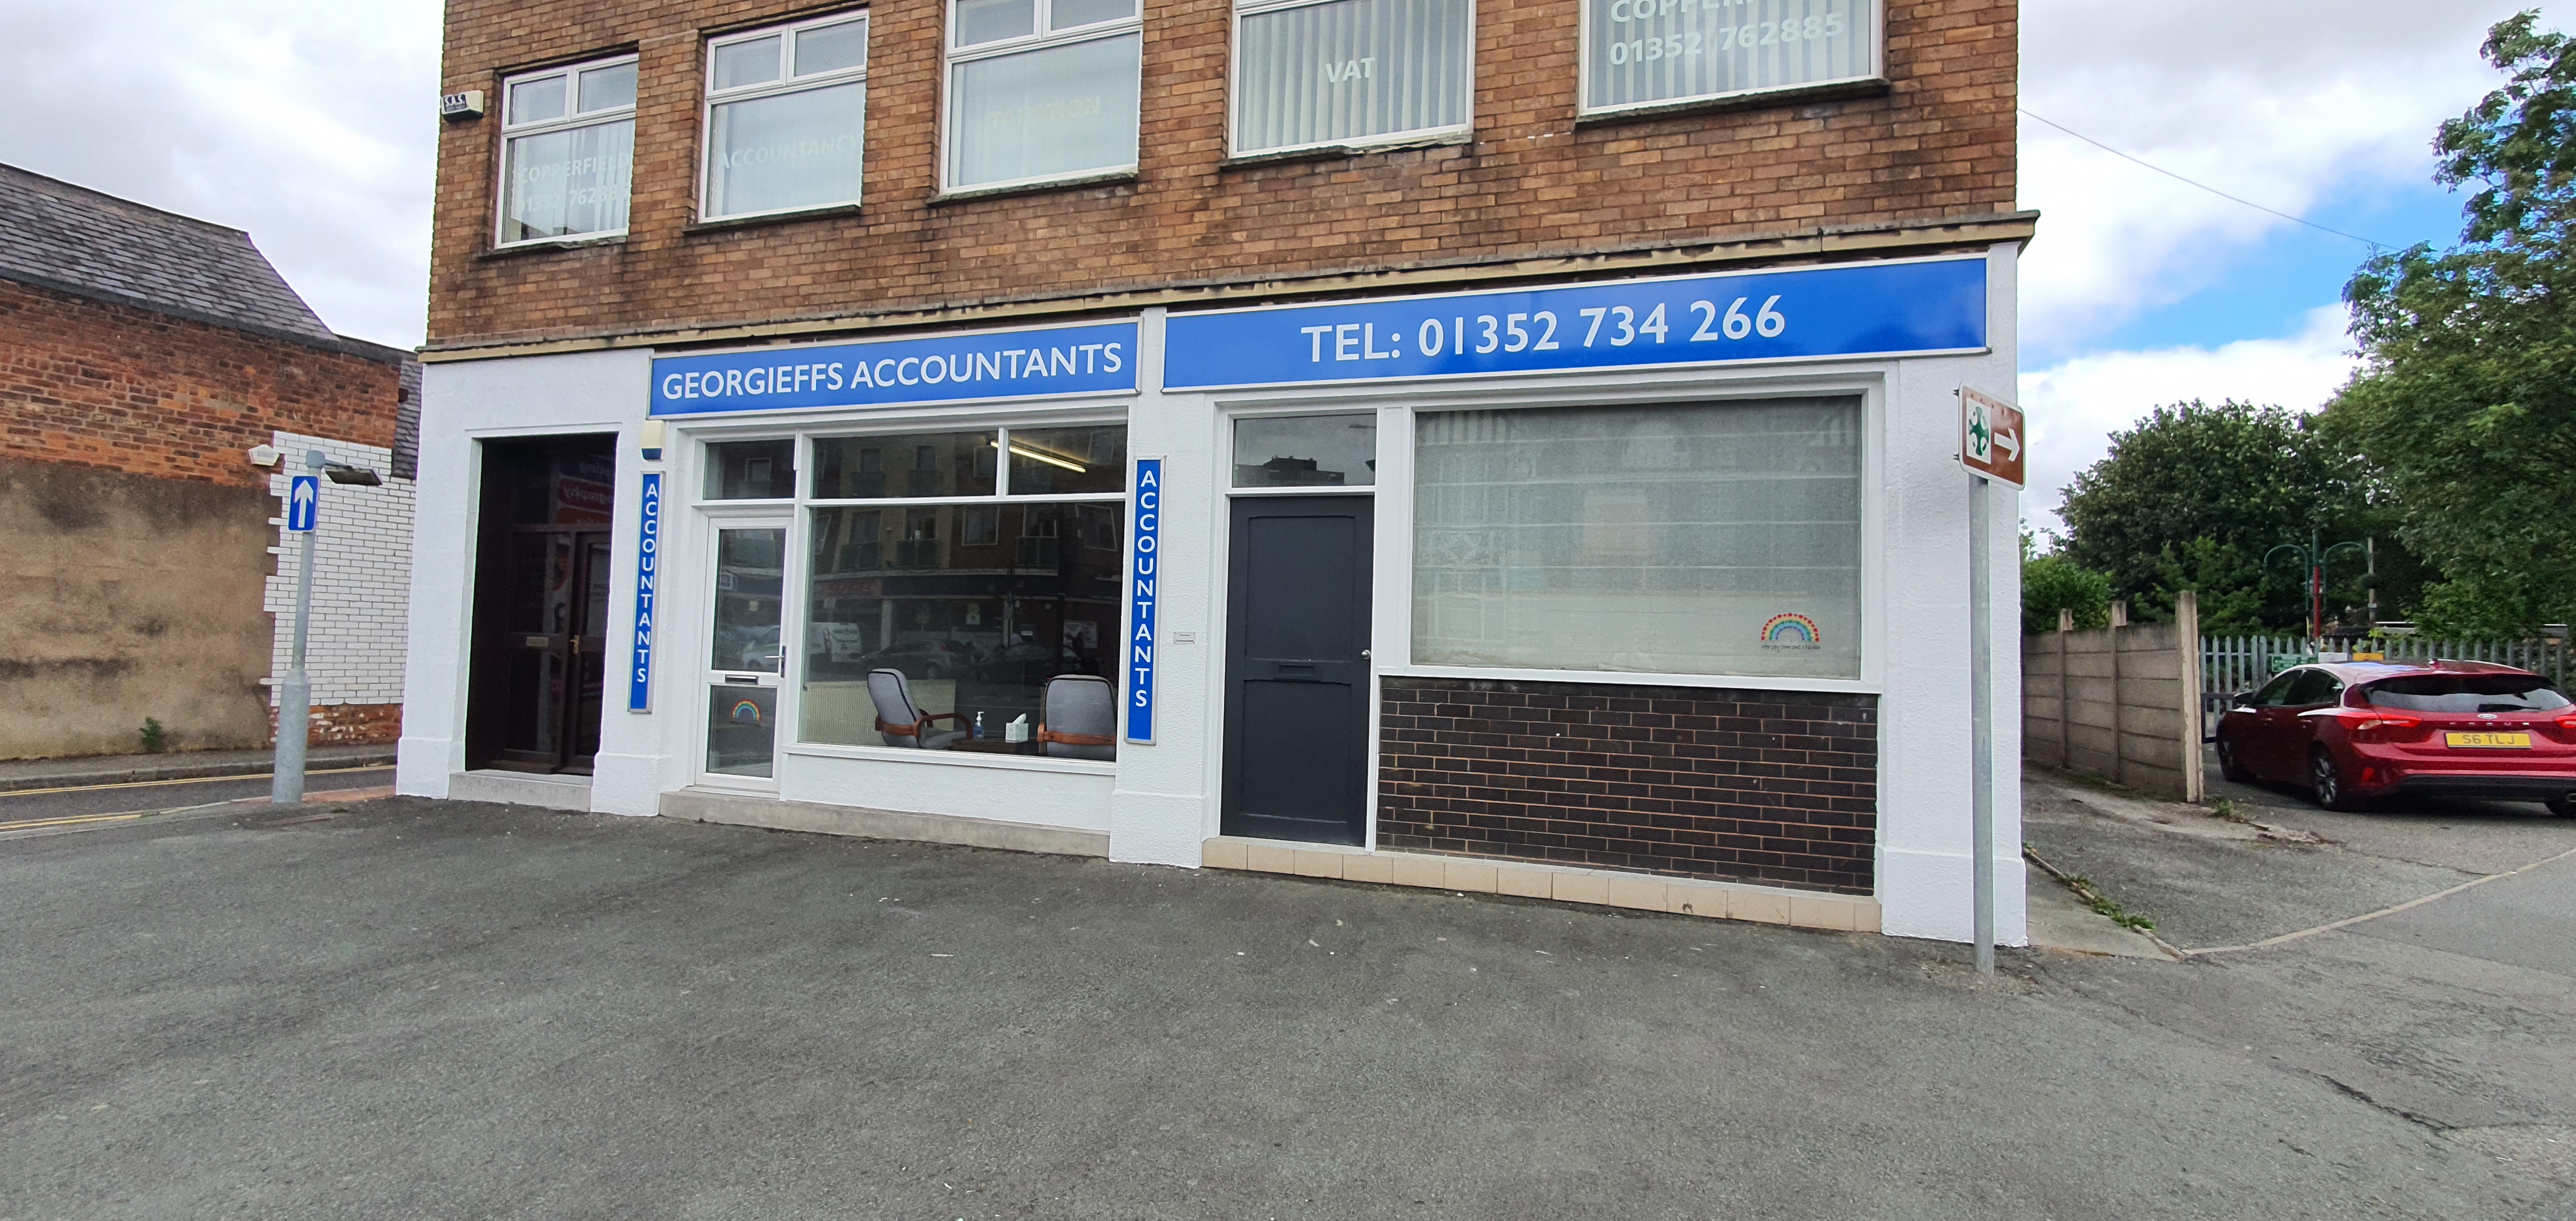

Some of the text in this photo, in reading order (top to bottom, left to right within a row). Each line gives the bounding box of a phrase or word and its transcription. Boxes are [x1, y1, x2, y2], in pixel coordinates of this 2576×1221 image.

[1610, 12, 1844, 65] 01352 762885
[1325, 57, 1376, 83] VAT
[718, 134, 861, 169] ACCOUNTANCY
[1301, 295, 1784, 362] TEL: 01352 734 266
[663, 343, 1121, 399] GEORGIEFFS ACCOUNTANTS
[637, 484, 657, 683] ACCOUNTANTS
[1135, 471, 1156, 707] ACCOUNTANTS
[2462, 734, 2515, 744] S6 TLJ
